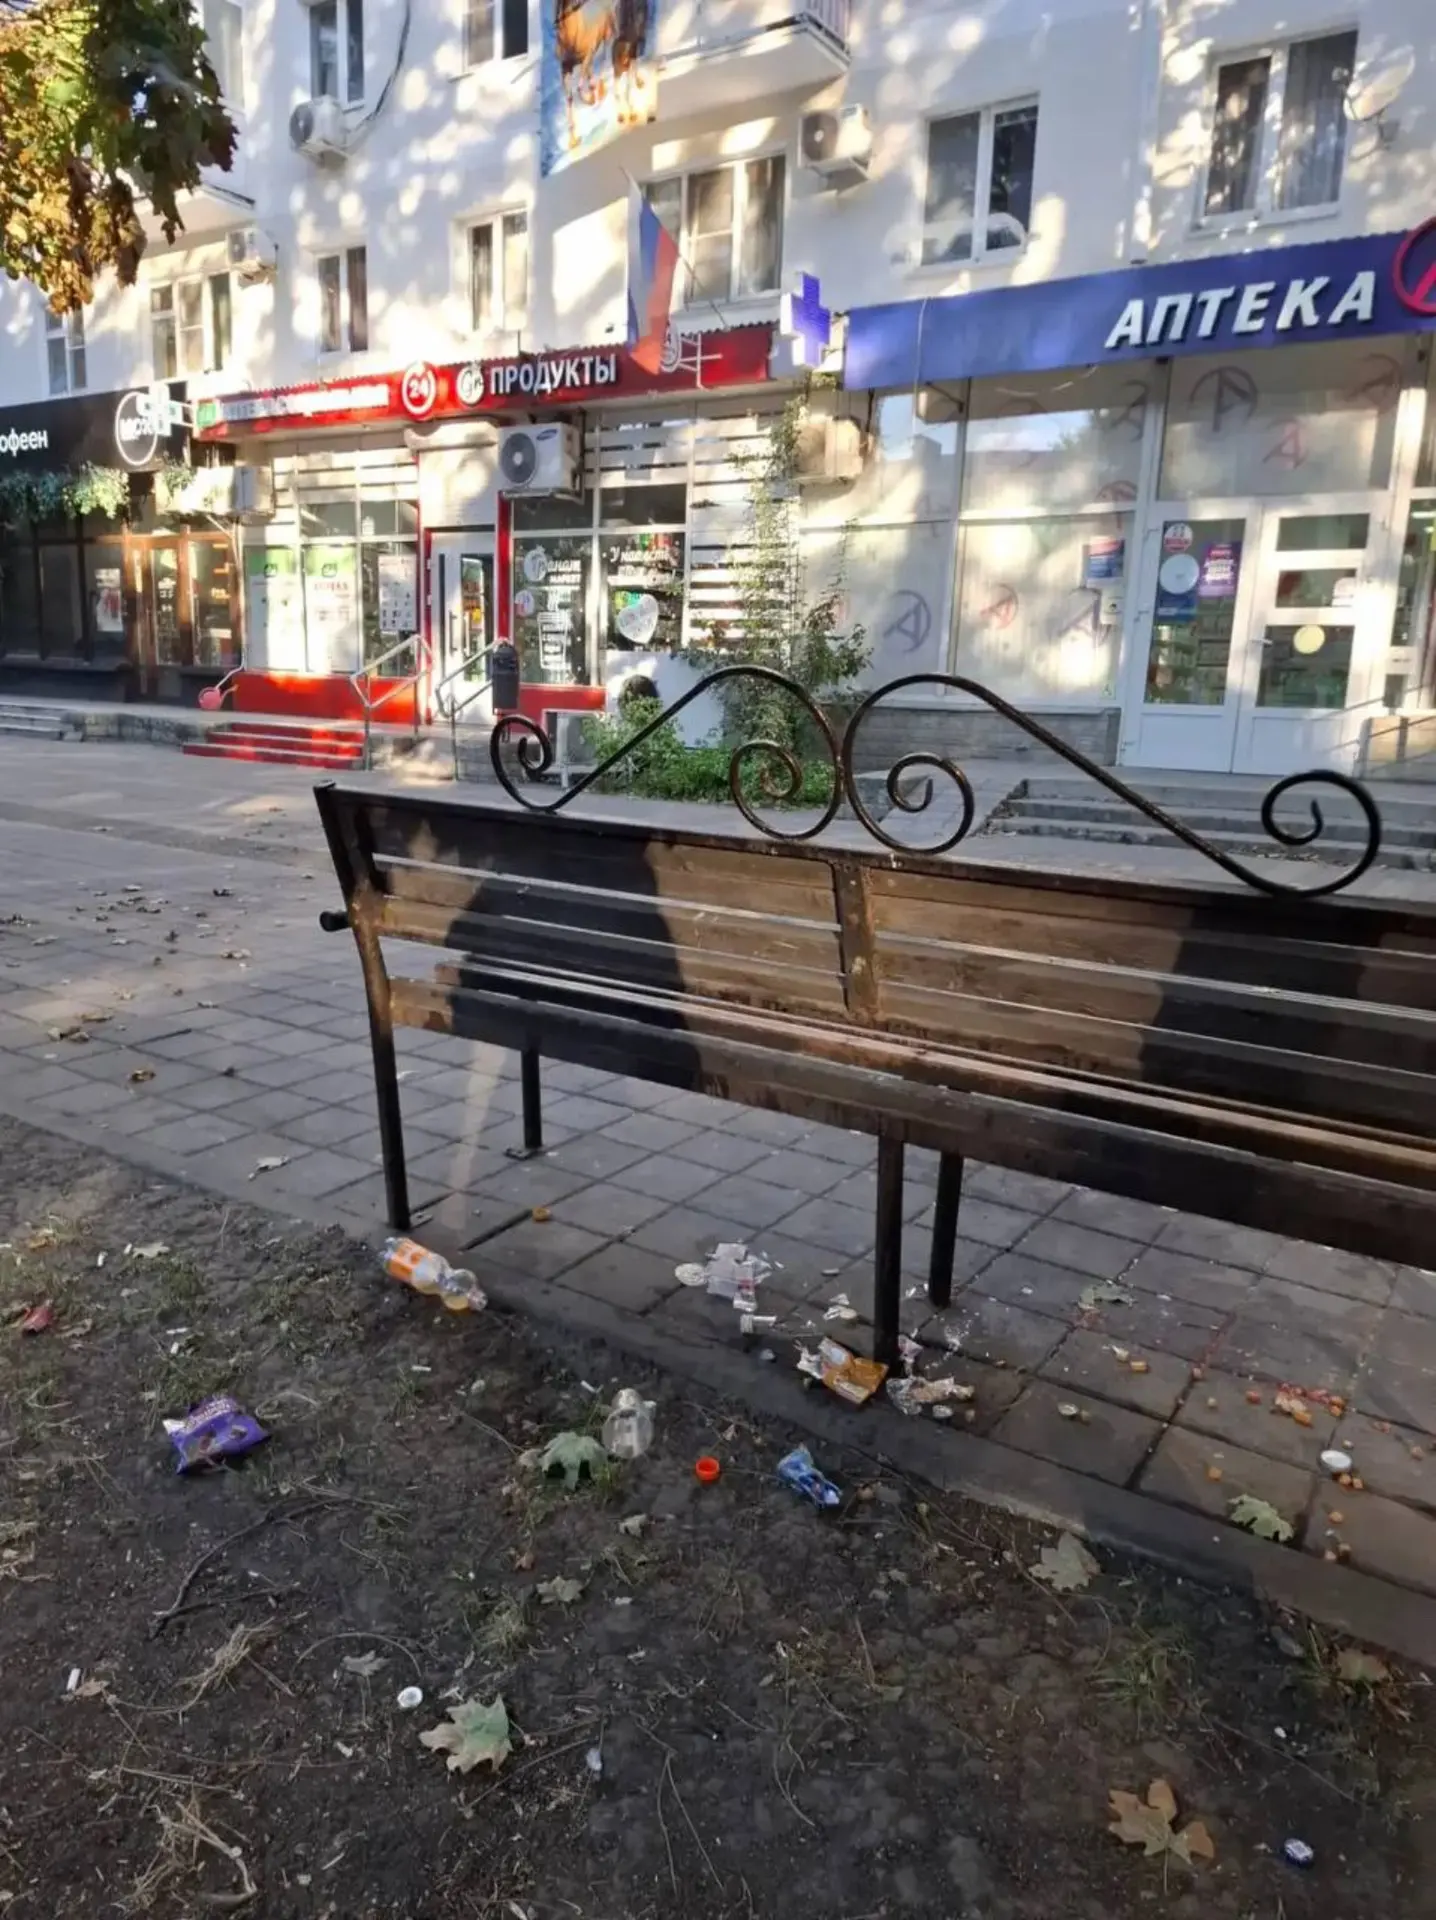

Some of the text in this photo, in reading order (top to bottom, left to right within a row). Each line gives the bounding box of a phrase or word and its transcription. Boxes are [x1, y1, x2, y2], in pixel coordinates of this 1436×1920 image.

[1104, 270, 1376, 349] АПТЕКА
[409, 379, 431, 399] 24
[489, 353, 617, 395] ПРОДУКТЫ
